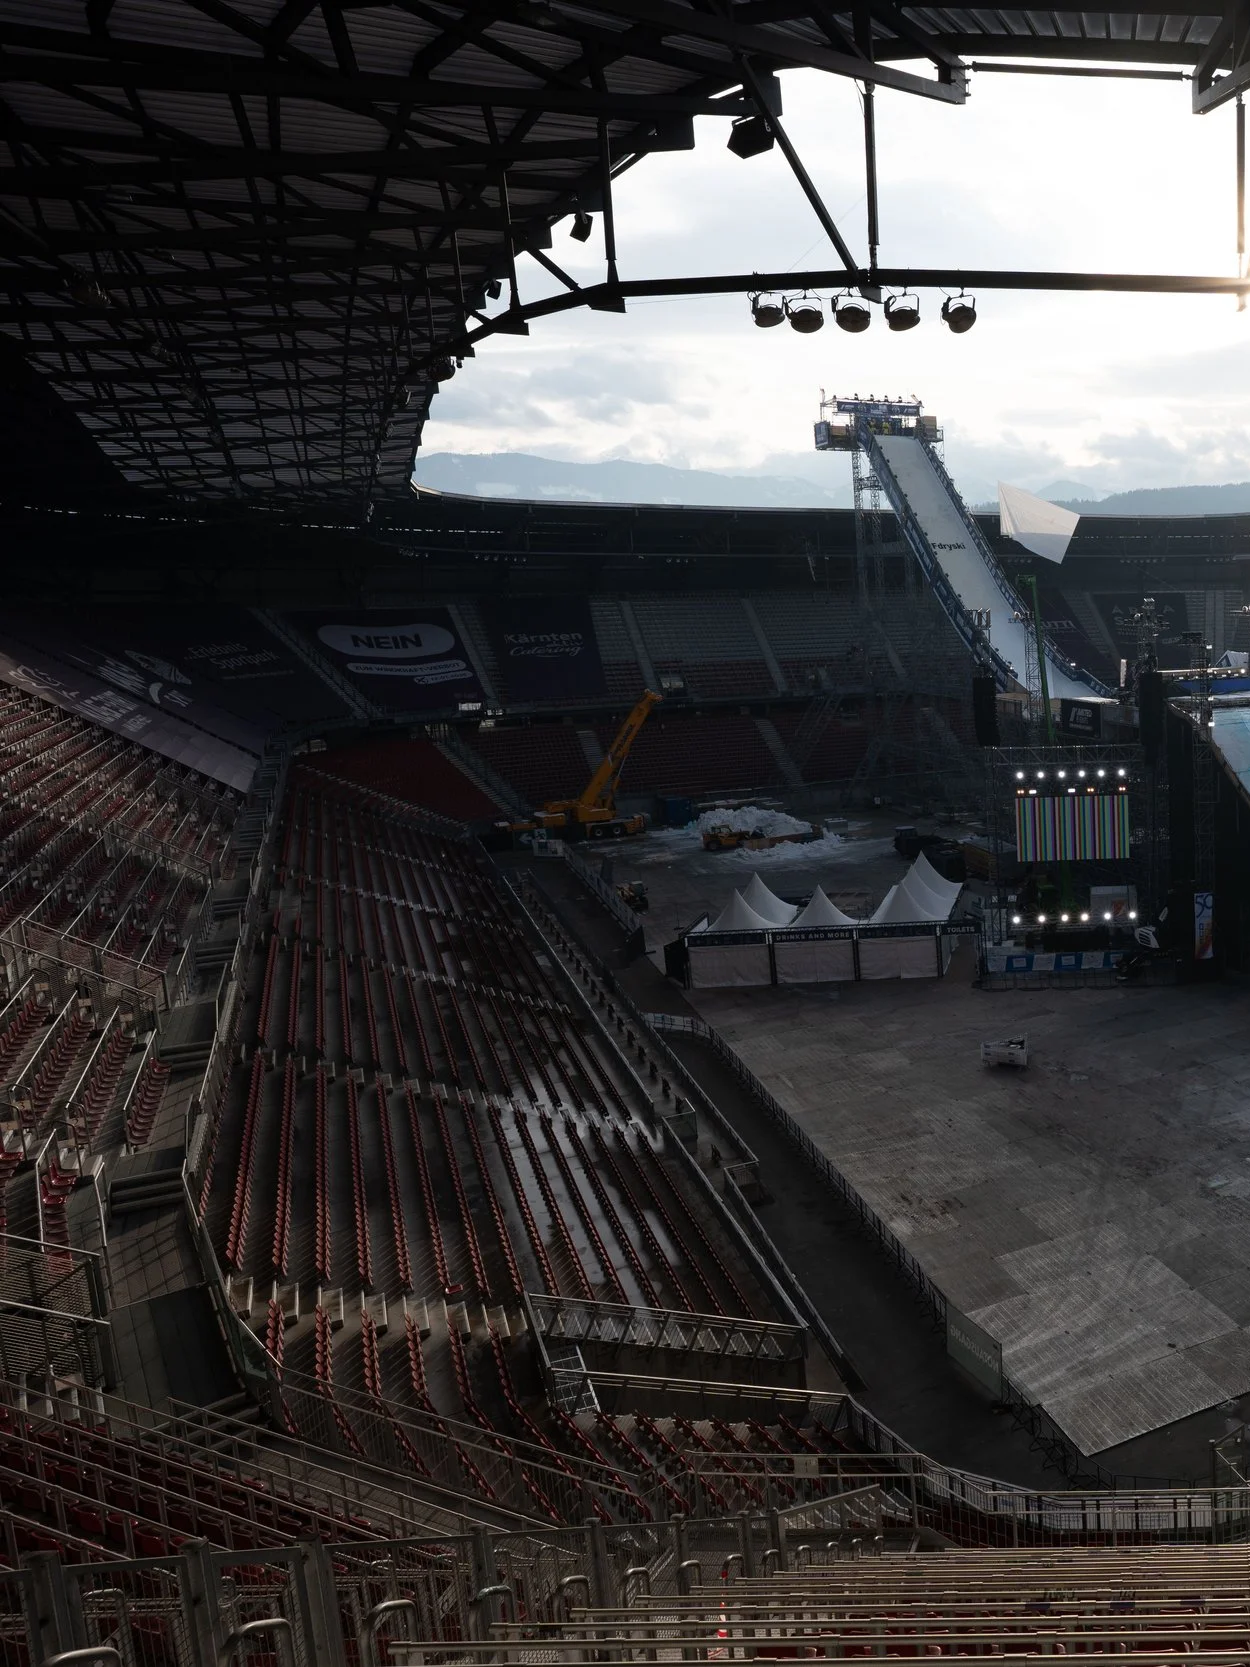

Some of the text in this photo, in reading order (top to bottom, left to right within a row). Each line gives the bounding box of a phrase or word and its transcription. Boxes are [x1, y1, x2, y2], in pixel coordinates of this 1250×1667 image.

[351, 633, 423, 649] NEIN
[504, 632, 582, 644] Kärnten
[776, 931, 850, 942] DRINKS AND MORE
